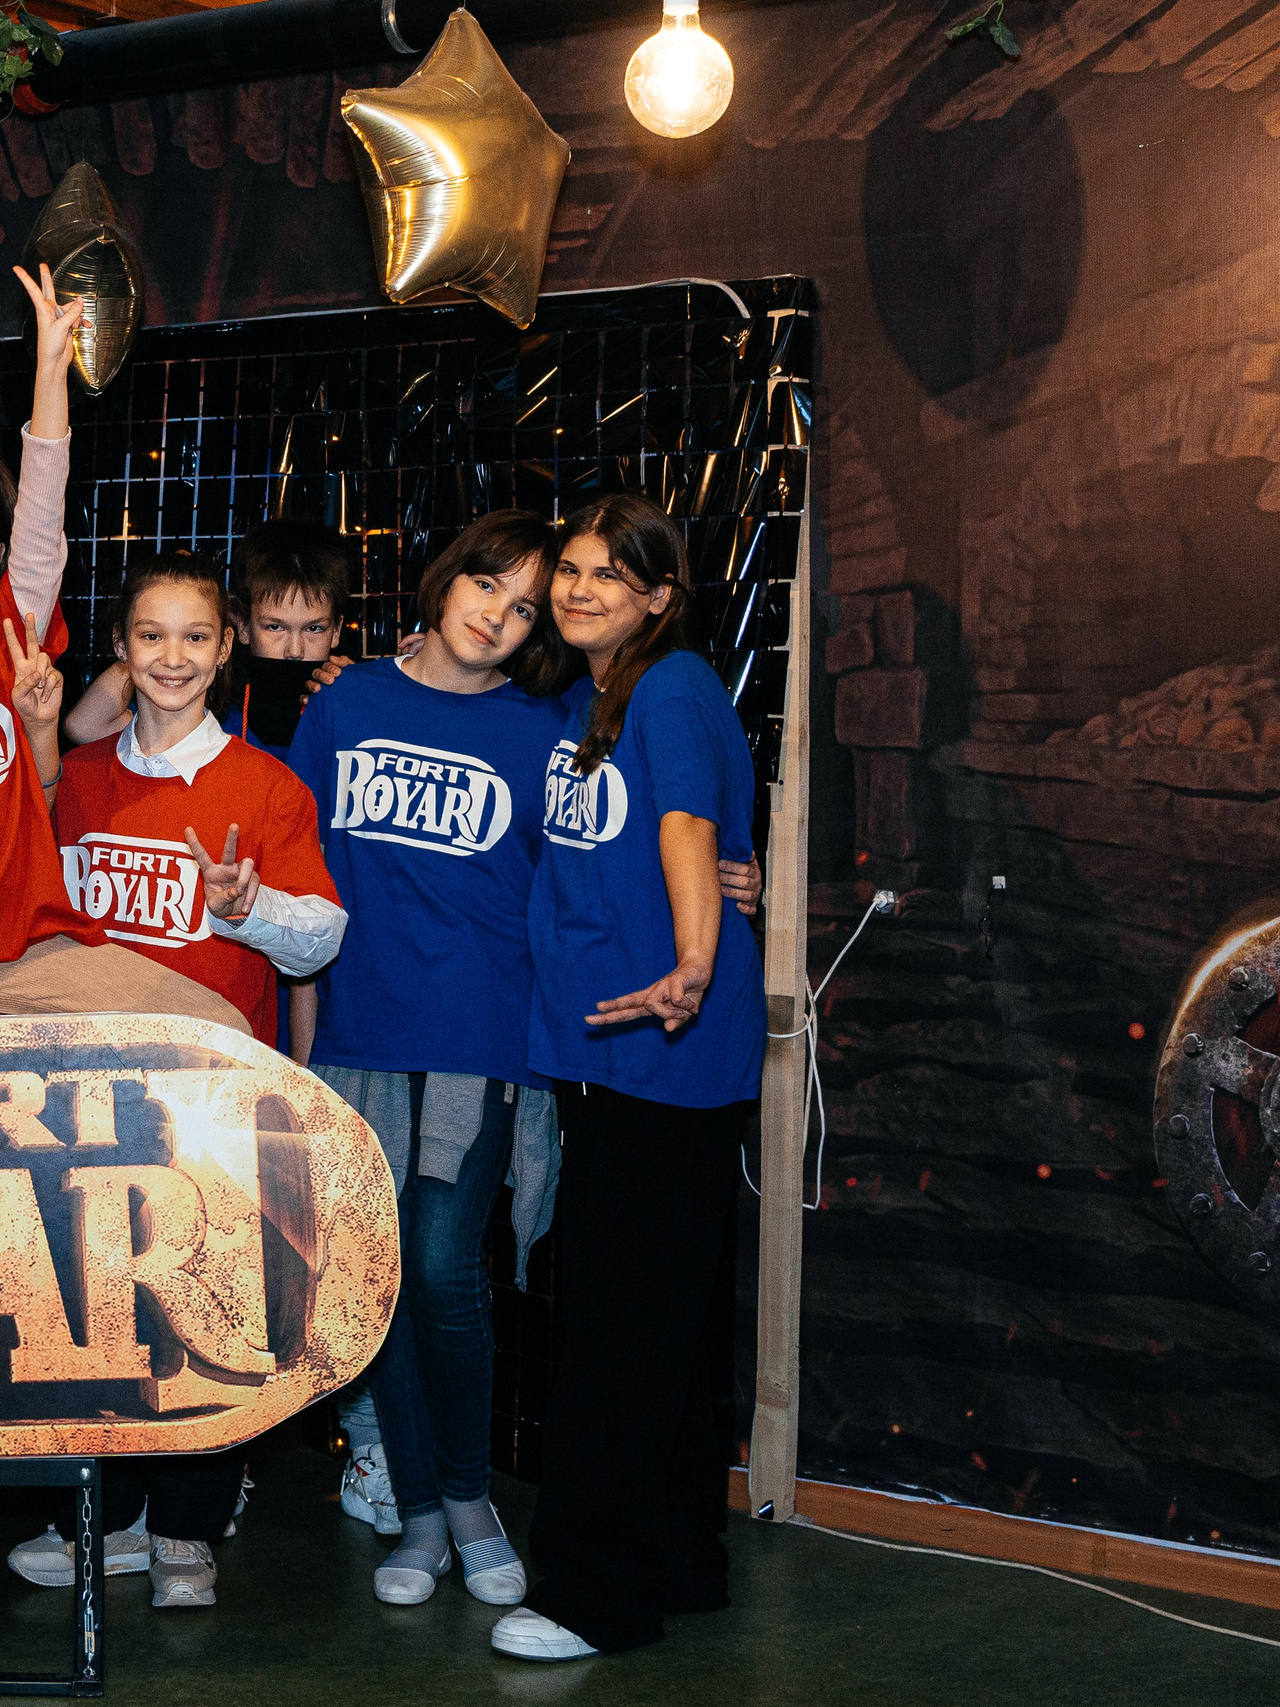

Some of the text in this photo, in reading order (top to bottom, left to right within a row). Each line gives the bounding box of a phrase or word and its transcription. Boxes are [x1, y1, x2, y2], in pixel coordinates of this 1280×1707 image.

[376, 752, 465, 783] FORT
[551, 753, 583, 778] FO
[331, 750, 512, 851] BOYARD
[544, 751, 628, 842] OYARD
[92, 847, 174, 874] FORT
